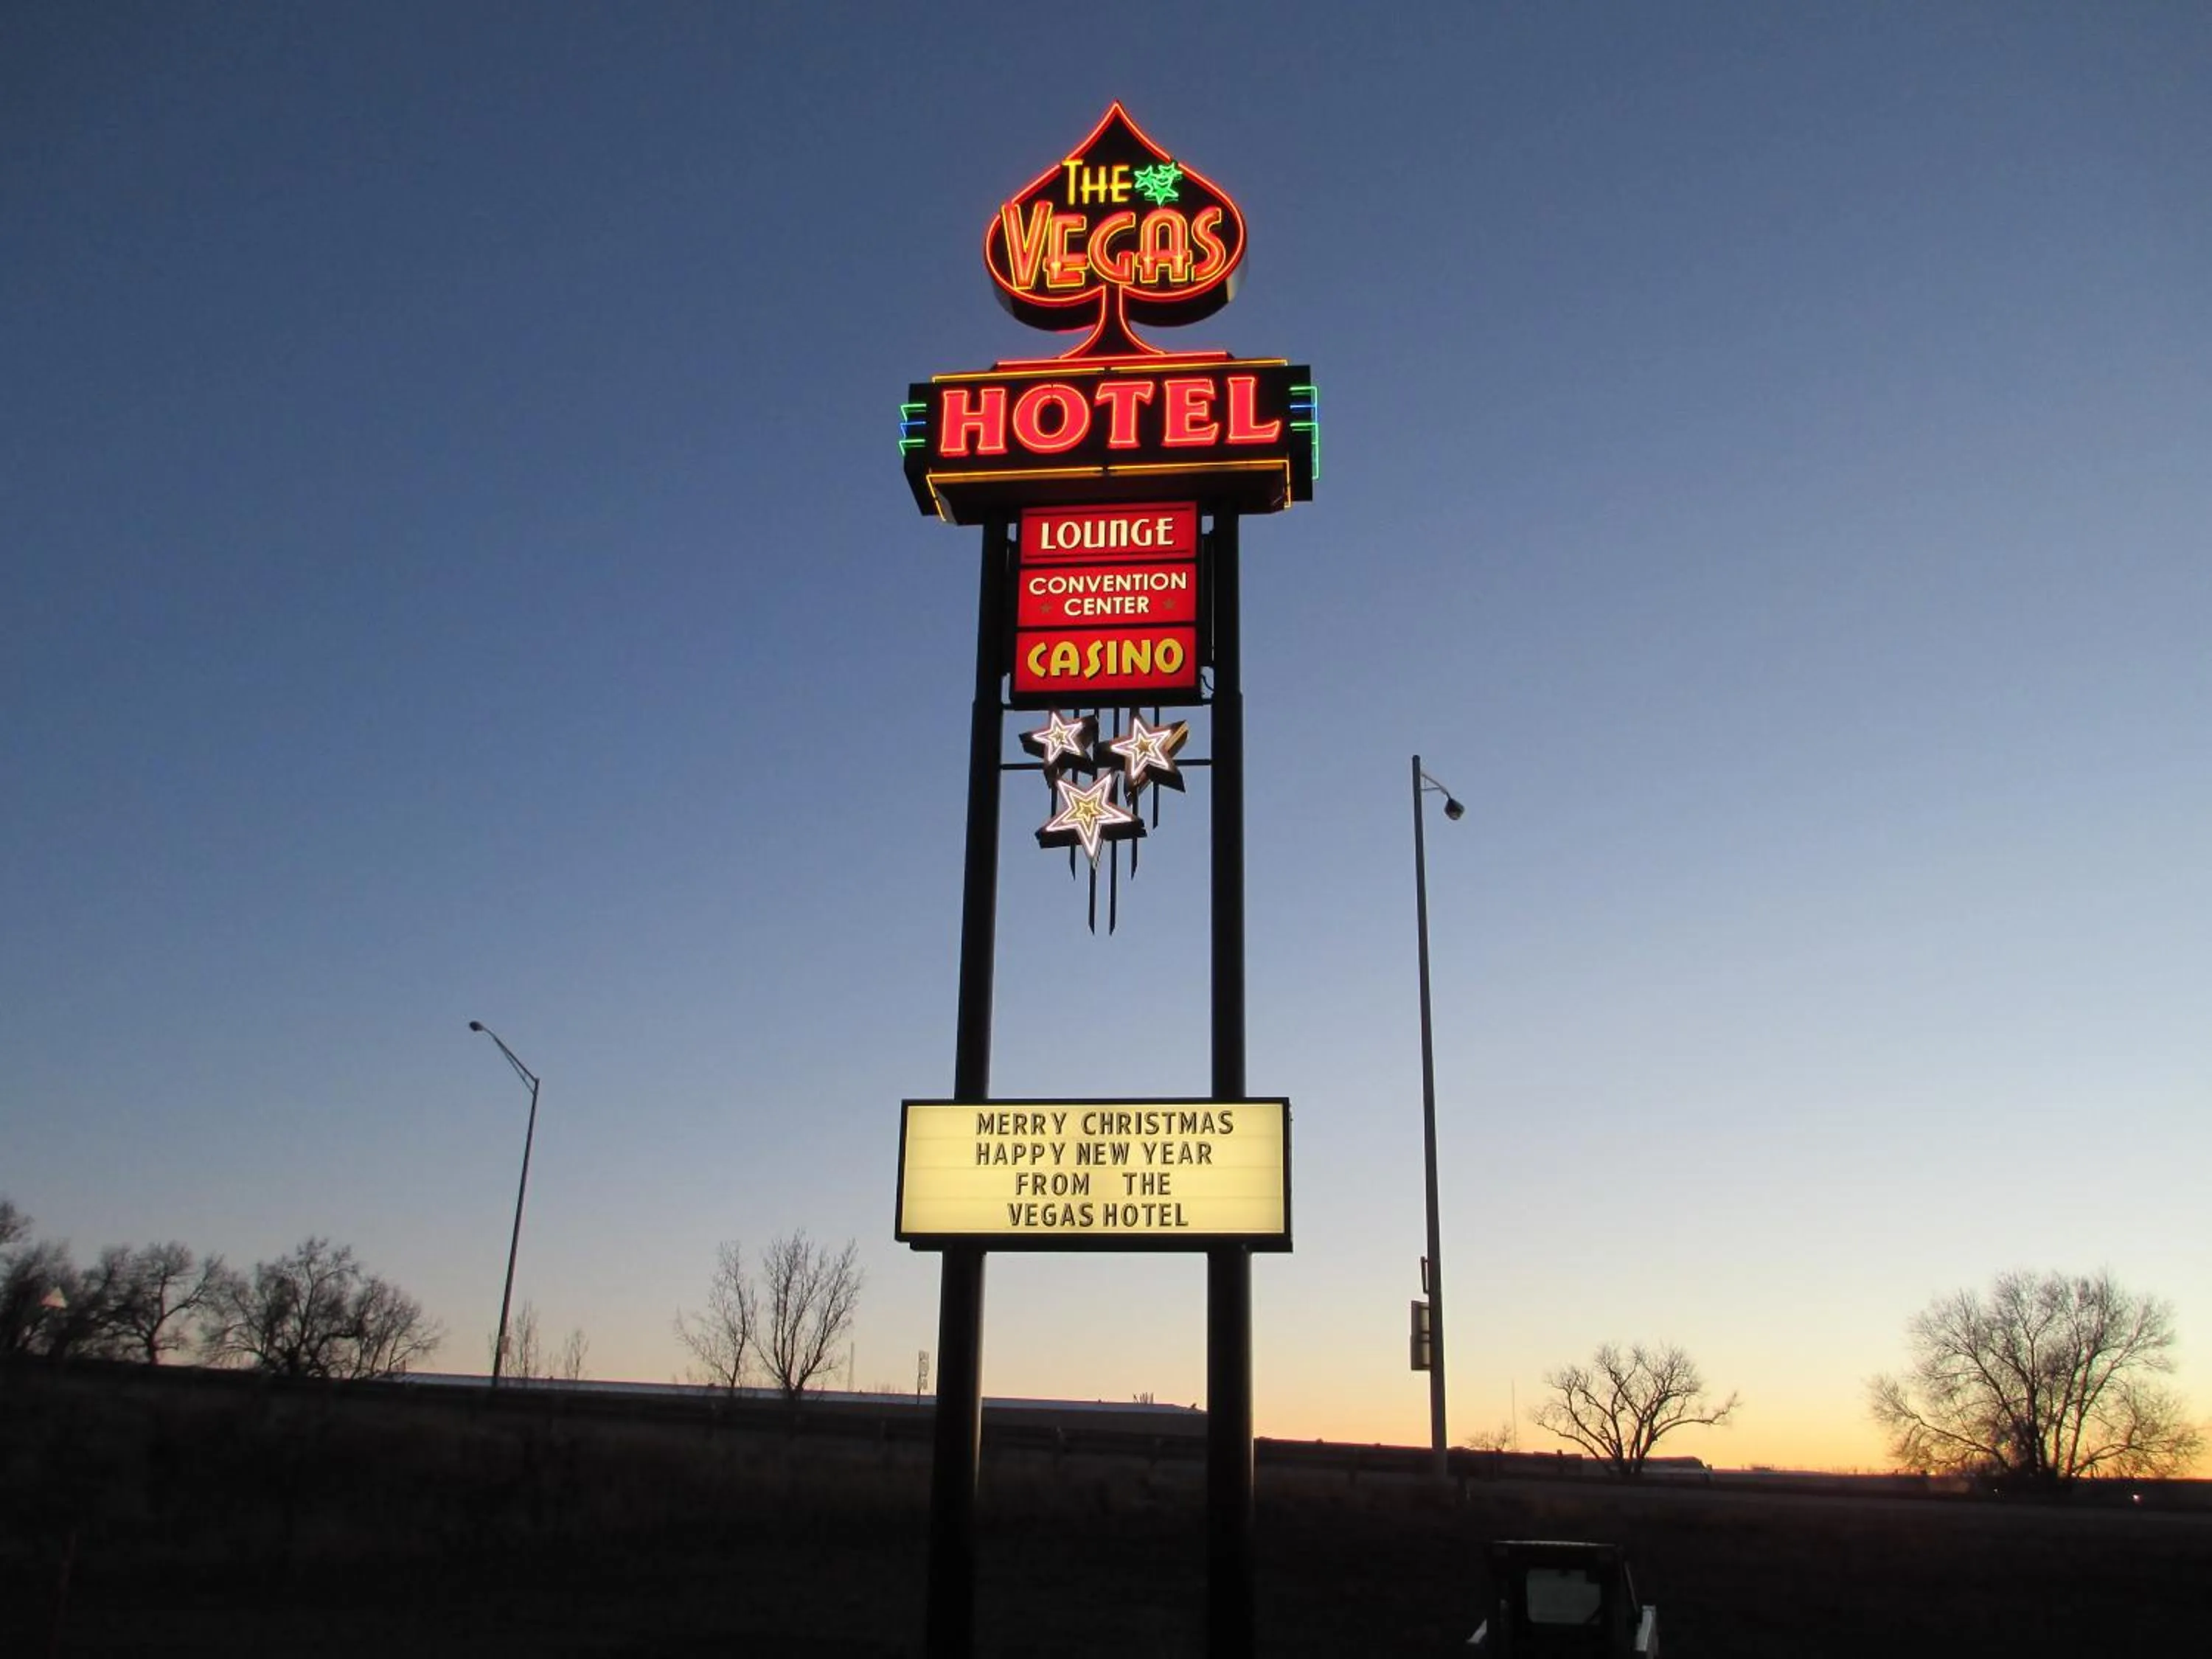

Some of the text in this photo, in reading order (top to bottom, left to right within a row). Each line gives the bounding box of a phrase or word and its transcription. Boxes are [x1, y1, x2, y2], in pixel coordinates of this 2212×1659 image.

[1062, 159, 1132, 204] THE
[1001, 201, 1227, 290] VEGAS
[940, 376, 1281, 457] HOTEL
[1040, 517, 1175, 549] LOUNGE
[1029, 572, 1187, 595] CONVENTION
[1064, 597, 1150, 616] CENTER
[1027, 638, 1183, 678] CASINO
[975, 1110, 1234, 1135] MERRY CHRISTMAS
[975, 1141, 1213, 1166] HAPPY NEW YEAR
[1015, 1172, 1172, 1196] FROM THE
[1007, 1203, 1189, 1227] VEGAS HOTEL
